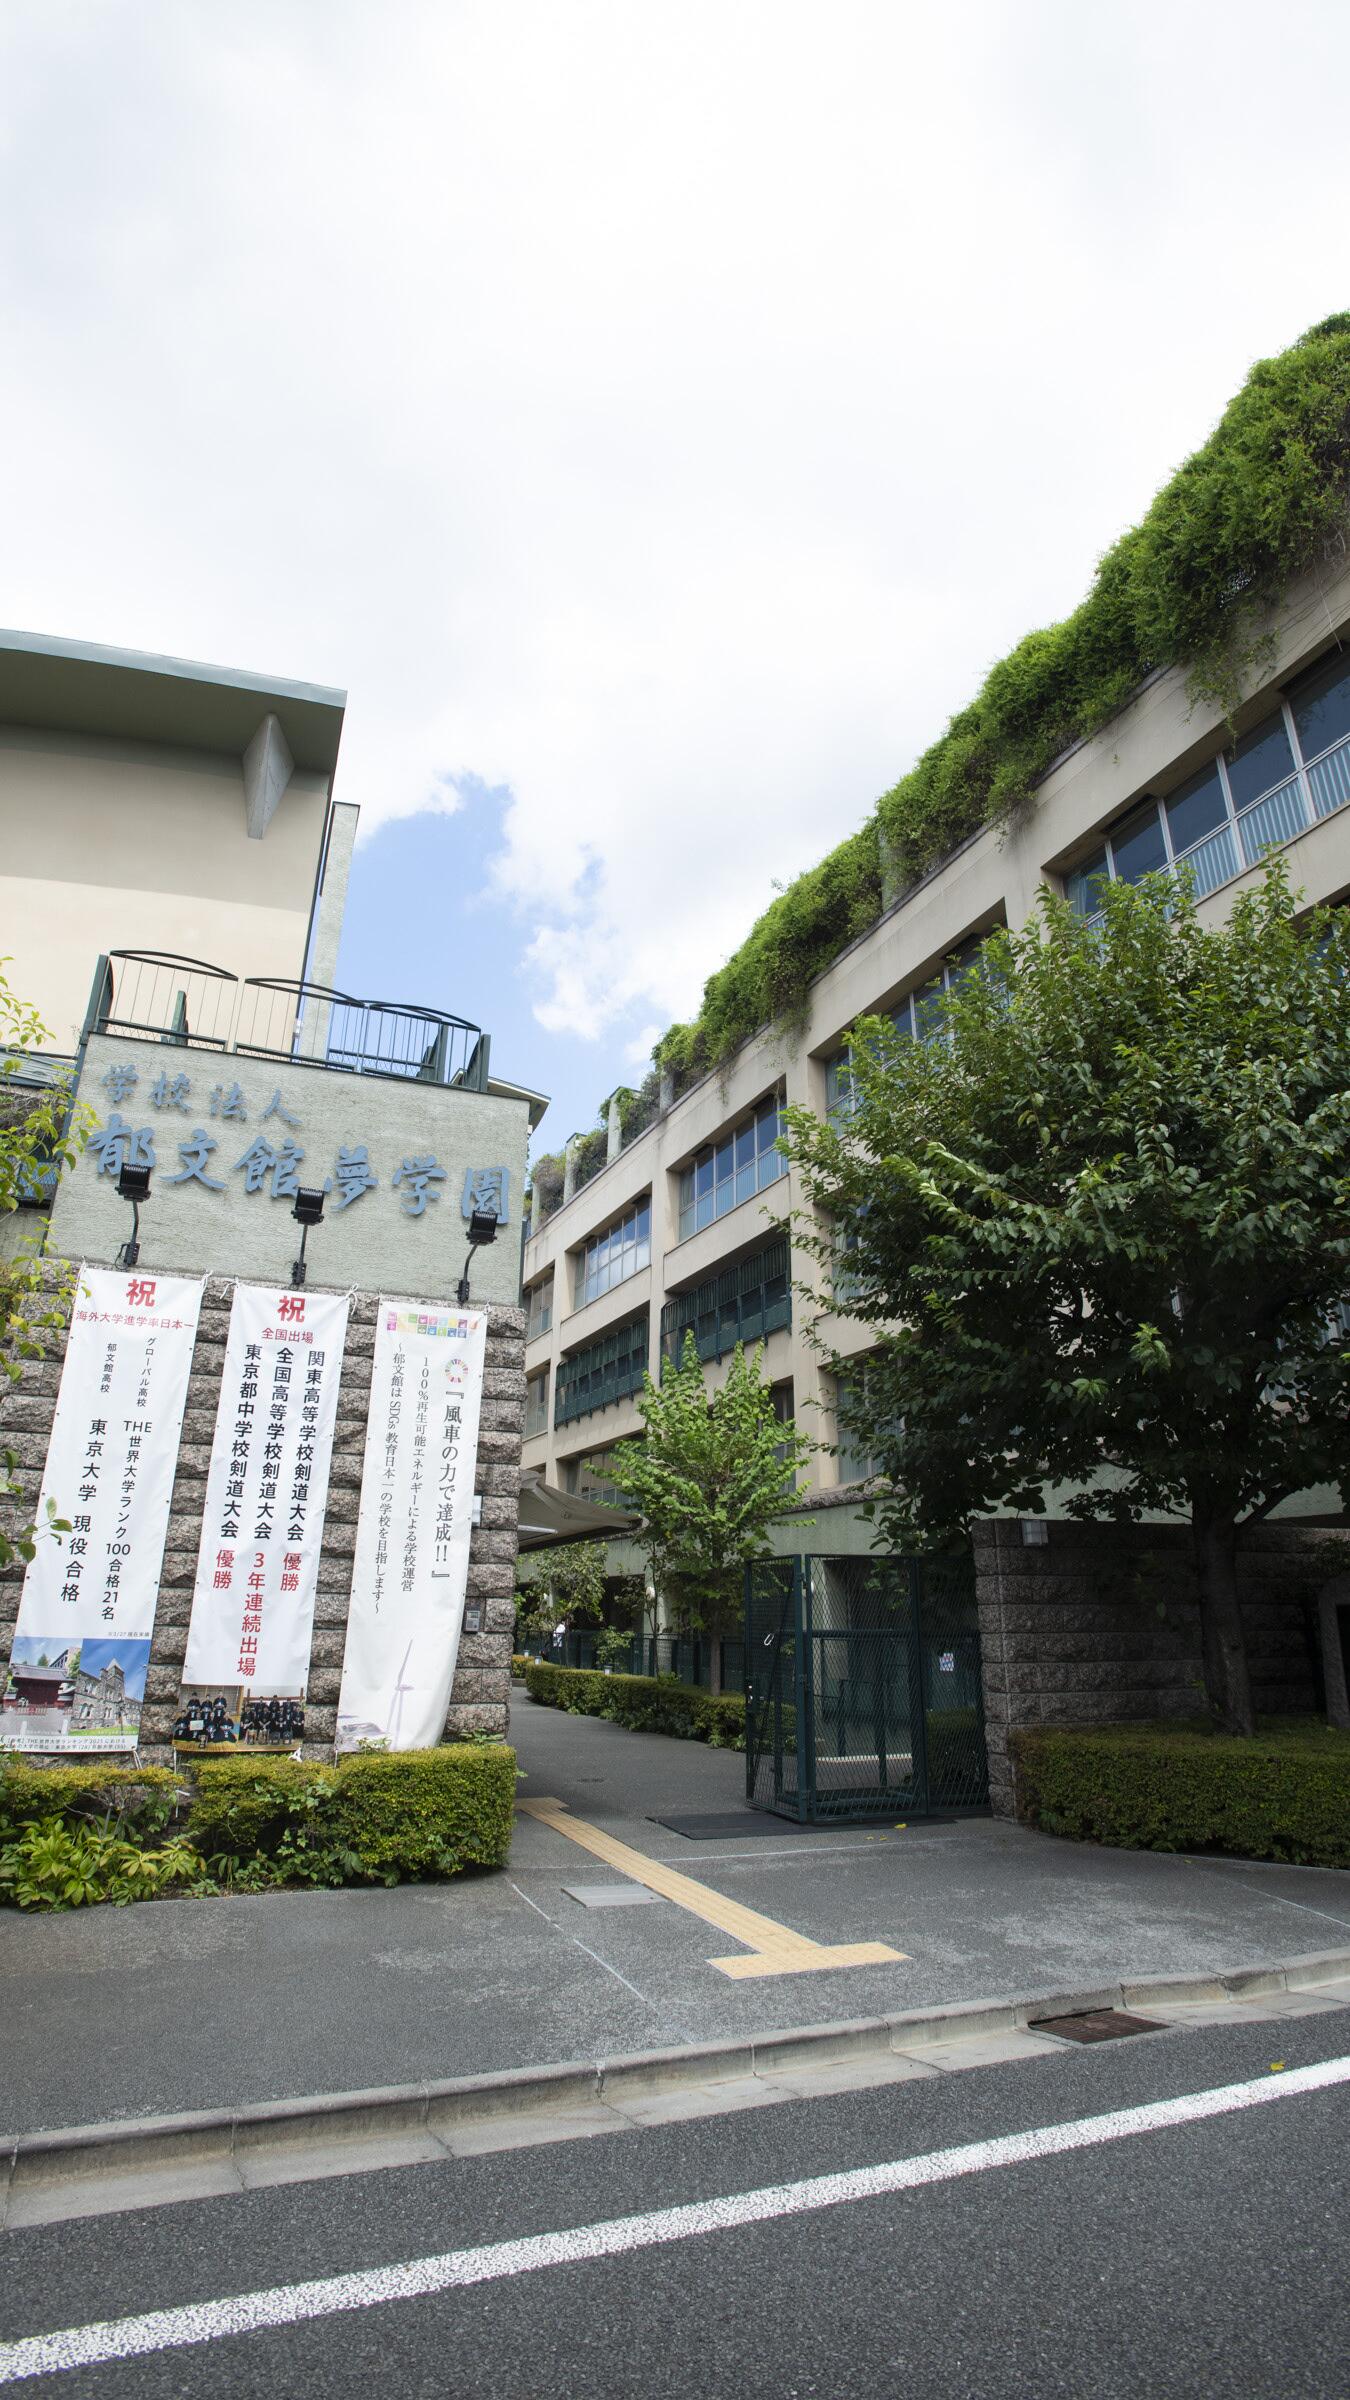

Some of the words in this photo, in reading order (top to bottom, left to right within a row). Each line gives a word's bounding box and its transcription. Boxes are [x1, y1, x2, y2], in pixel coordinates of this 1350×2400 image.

[101, 1064, 303, 1125] 学校法人
[86, 1112, 510, 1224] 郁文館夢学園
[76, 1310, 195, 1329] 海外大学進学率日本一
[125, 1278, 157, 1307] 祝
[277, 1295, 306, 1323] 祝
[261, 1327, 314, 1344] 全国出場
[100, 1343, 117, 1393] 郁文館高校
[136, 1337, 157, 1407] グローバル高校
[220, 1344, 263, 1539] 東京都中学校剣道大会
[253, 1347, 294, 1540] 全国高等学校剣道大会
[287, 1350, 325, 1541] 関東高等学校剣道大会
[212, 1549, 235, 1589] 優勝
[280, 1552, 302, 1592] 優勝
[237, 1552, 266, 1677] 3年連続出場
